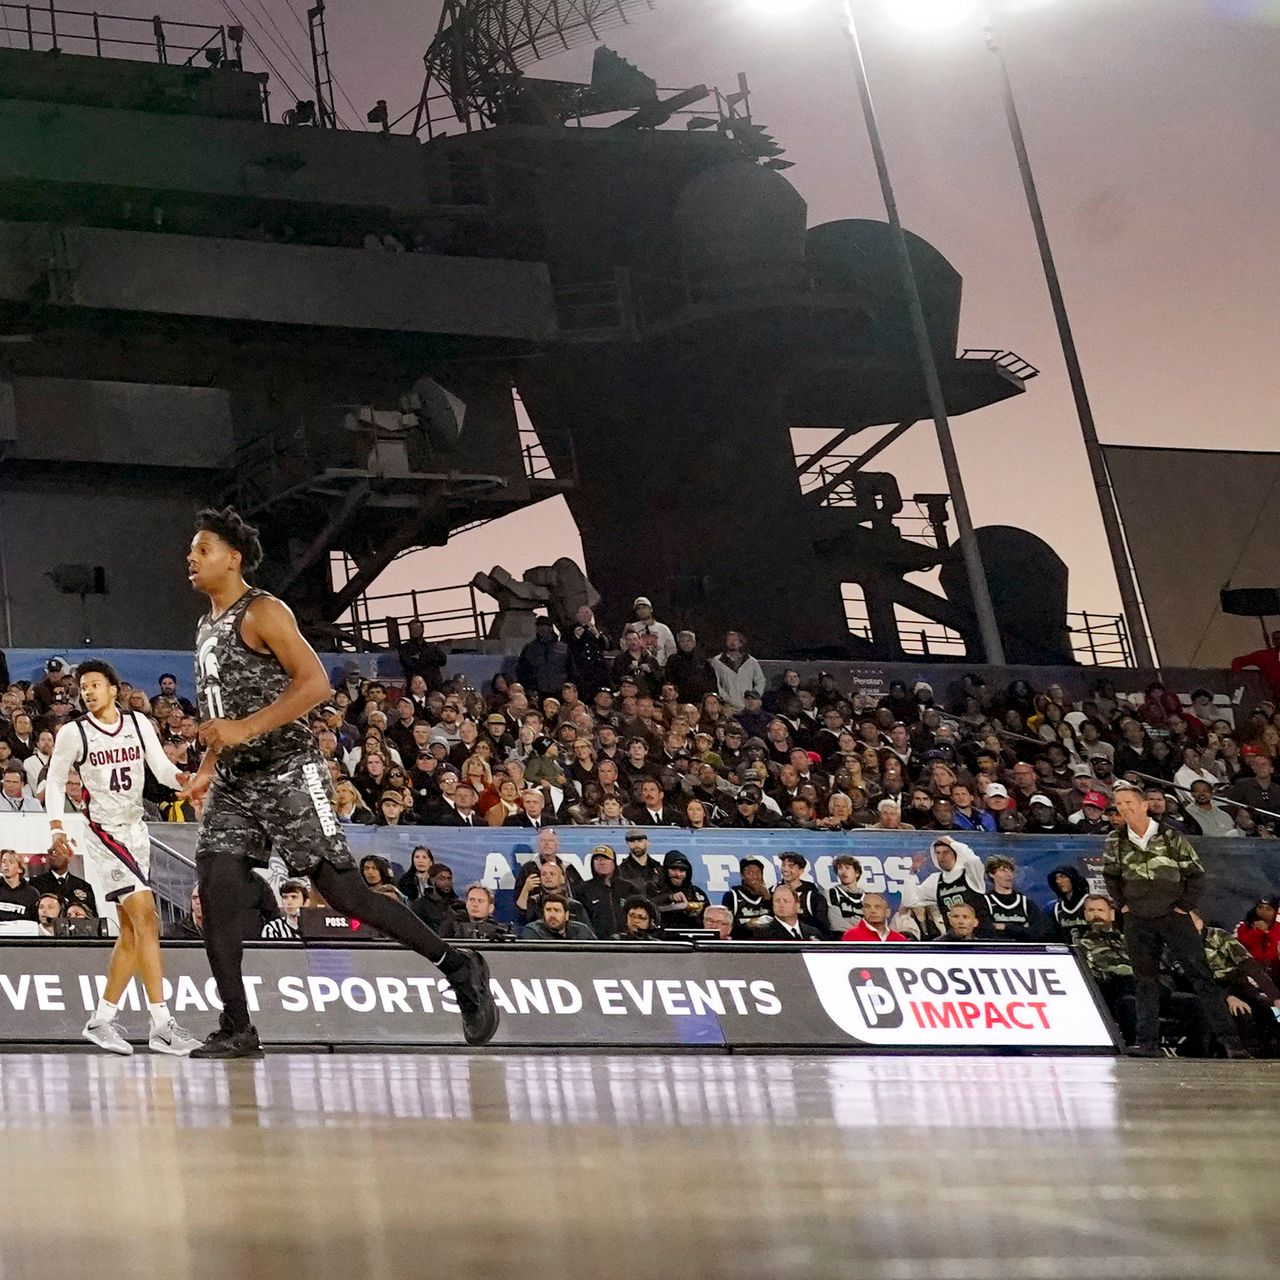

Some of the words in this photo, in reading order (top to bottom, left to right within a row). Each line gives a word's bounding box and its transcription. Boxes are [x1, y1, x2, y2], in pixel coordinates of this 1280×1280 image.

[89, 746, 141, 767] GONZAGA
[109, 766, 133, 793] 45
[301, 762, 338, 837] SPARTANS
[325, 916, 349, 928] POSS.
[278, 976, 462, 1014] SPORTS
[489, 978, 583, 1015] AND
[593, 979, 783, 1016] EVENTS
[895, 967, 1068, 996] POSITIVE
[909, 1001, 1052, 1030] IMPACT
